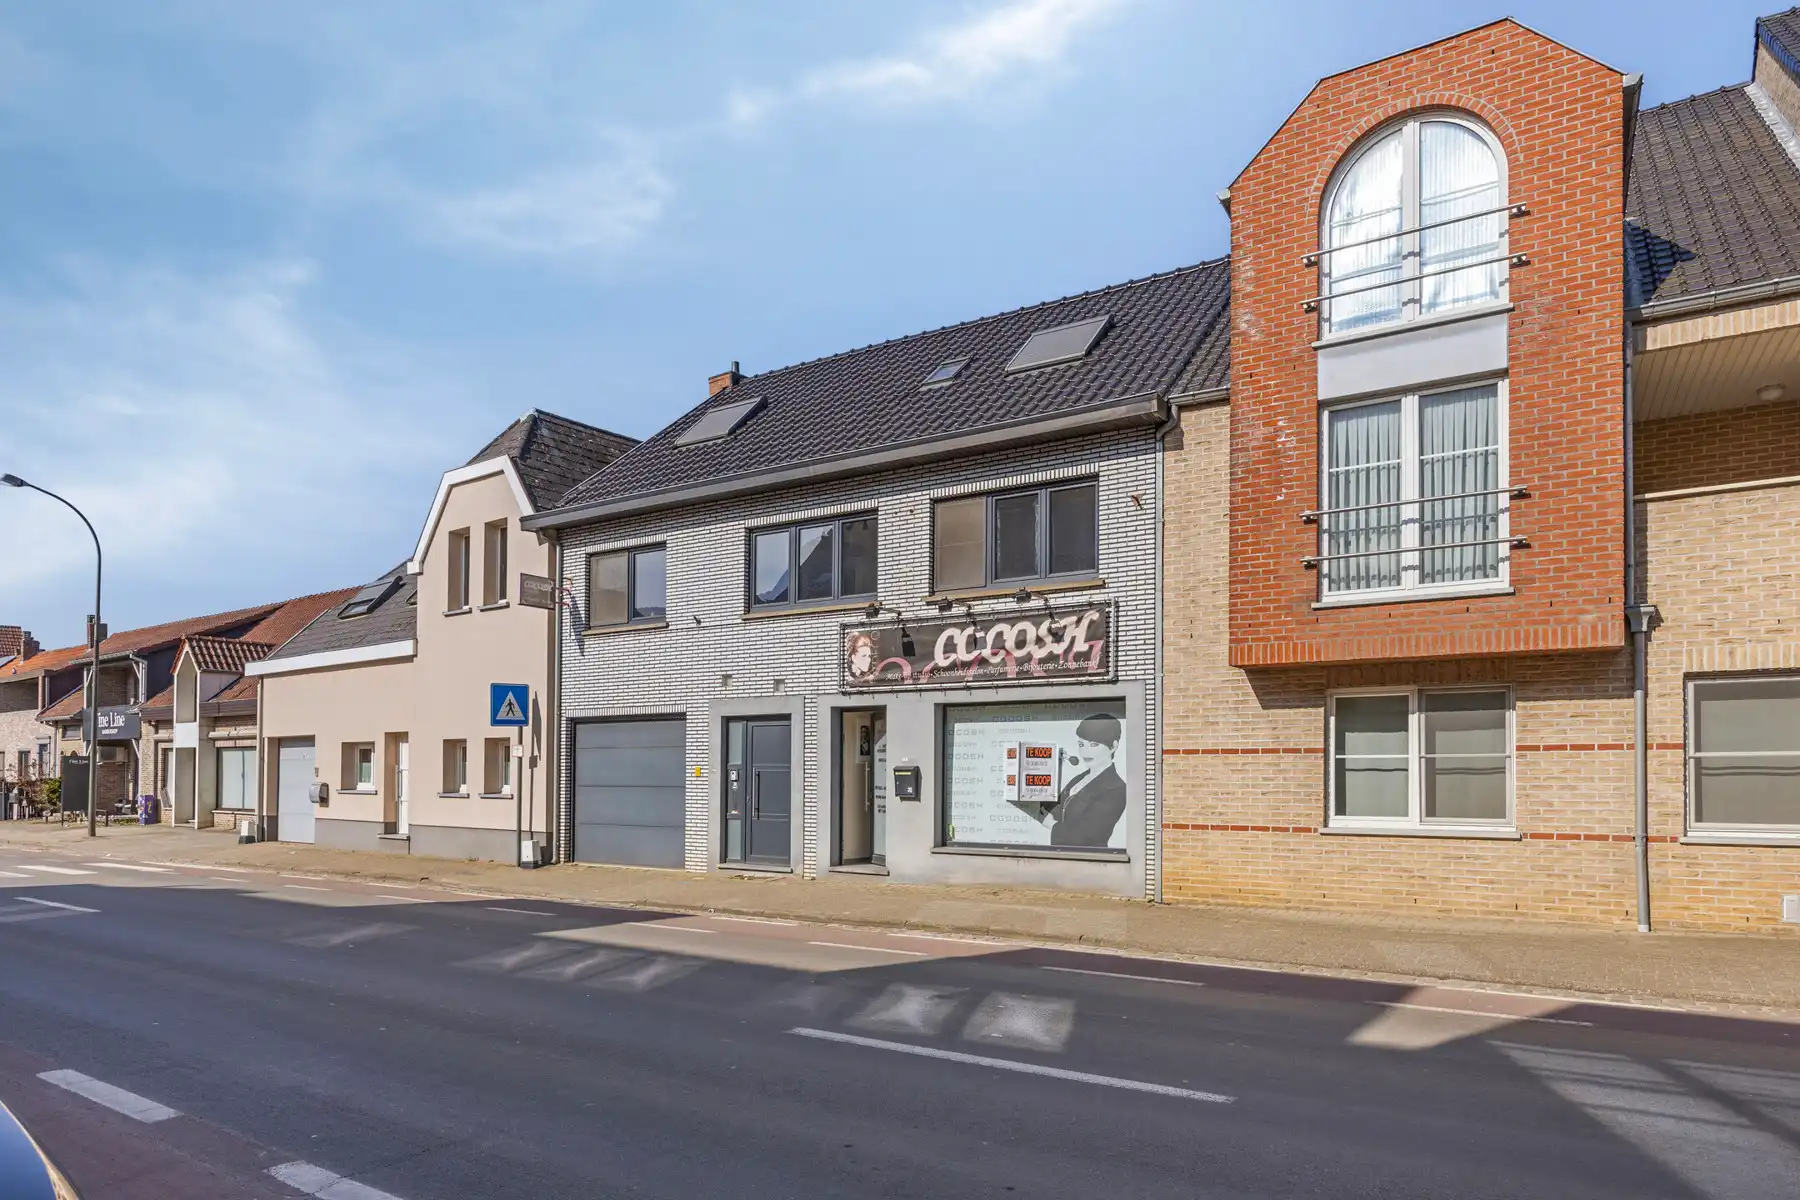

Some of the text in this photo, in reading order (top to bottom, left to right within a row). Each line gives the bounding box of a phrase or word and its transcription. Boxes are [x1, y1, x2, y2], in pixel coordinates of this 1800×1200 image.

[109, 712, 125, 727] Line
[1027, 747, 1034, 757] TE
[1035, 747, 1052, 757] KOOP
[1027, 775, 1033, 785] TE
[1034, 775, 1051, 785] KOOP
